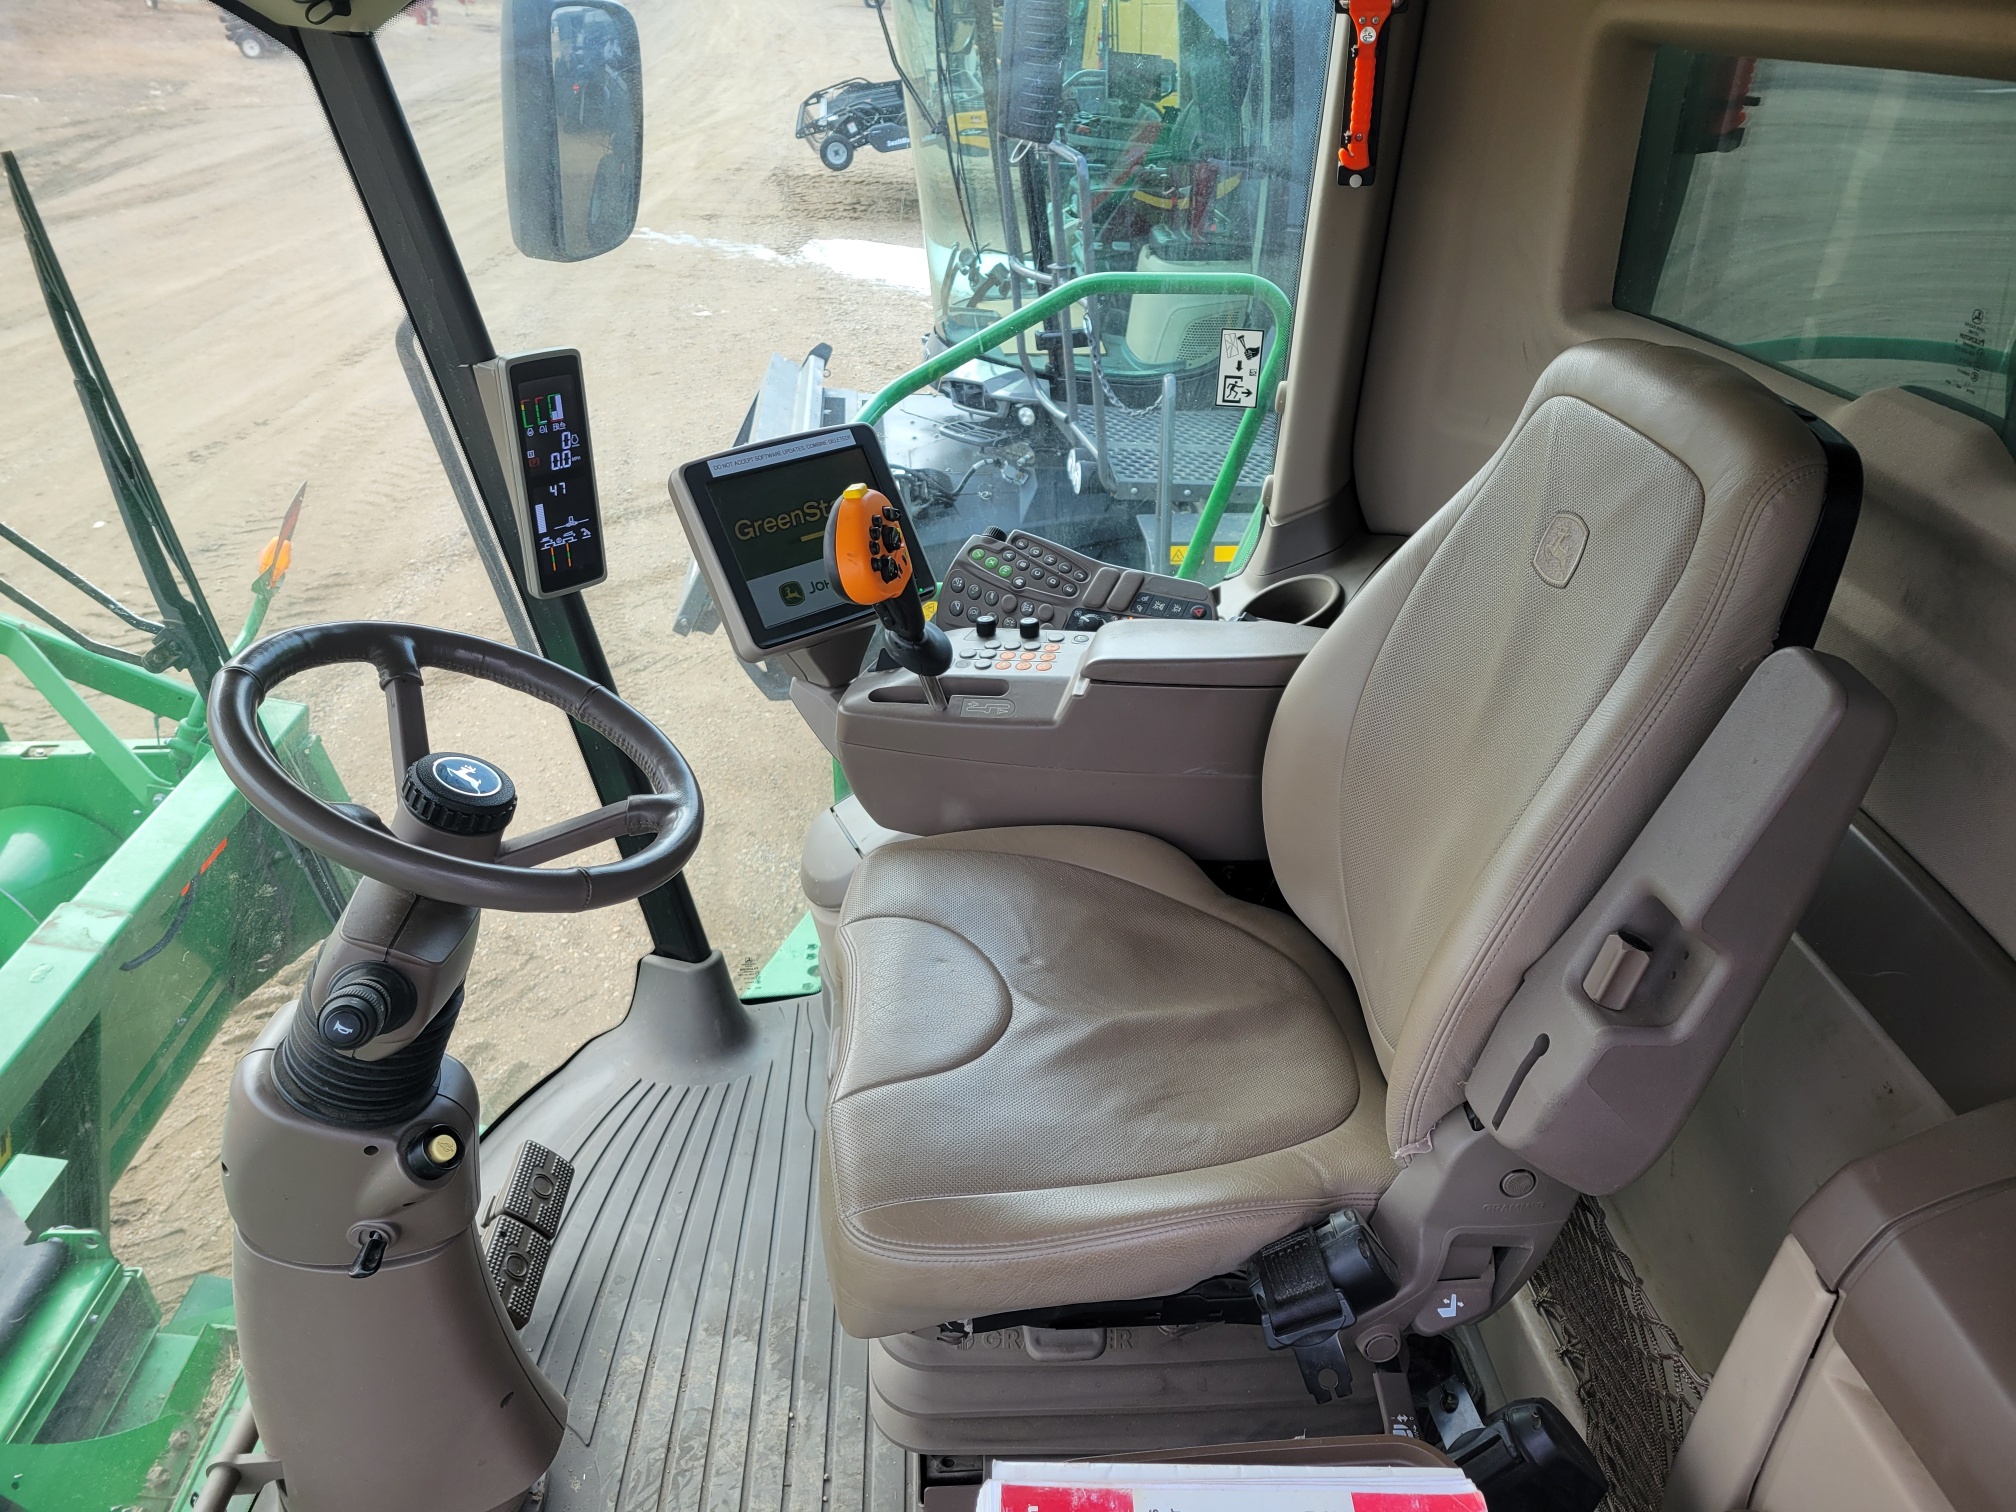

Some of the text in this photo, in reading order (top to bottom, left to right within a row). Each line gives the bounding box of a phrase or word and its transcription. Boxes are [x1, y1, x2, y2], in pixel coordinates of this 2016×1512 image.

[886, 136, 911, 147] SwathMa
[561, 431, 572, 450] 0
[550, 450, 572, 471] 0.0
[722, 461, 733, 469] NOT
[734, 457, 754, 466] ACCEPT
[754, 451, 783, 462] SOFTWARE
[806, 439, 828, 450] COMBINE
[549, 482, 567, 497] 47
